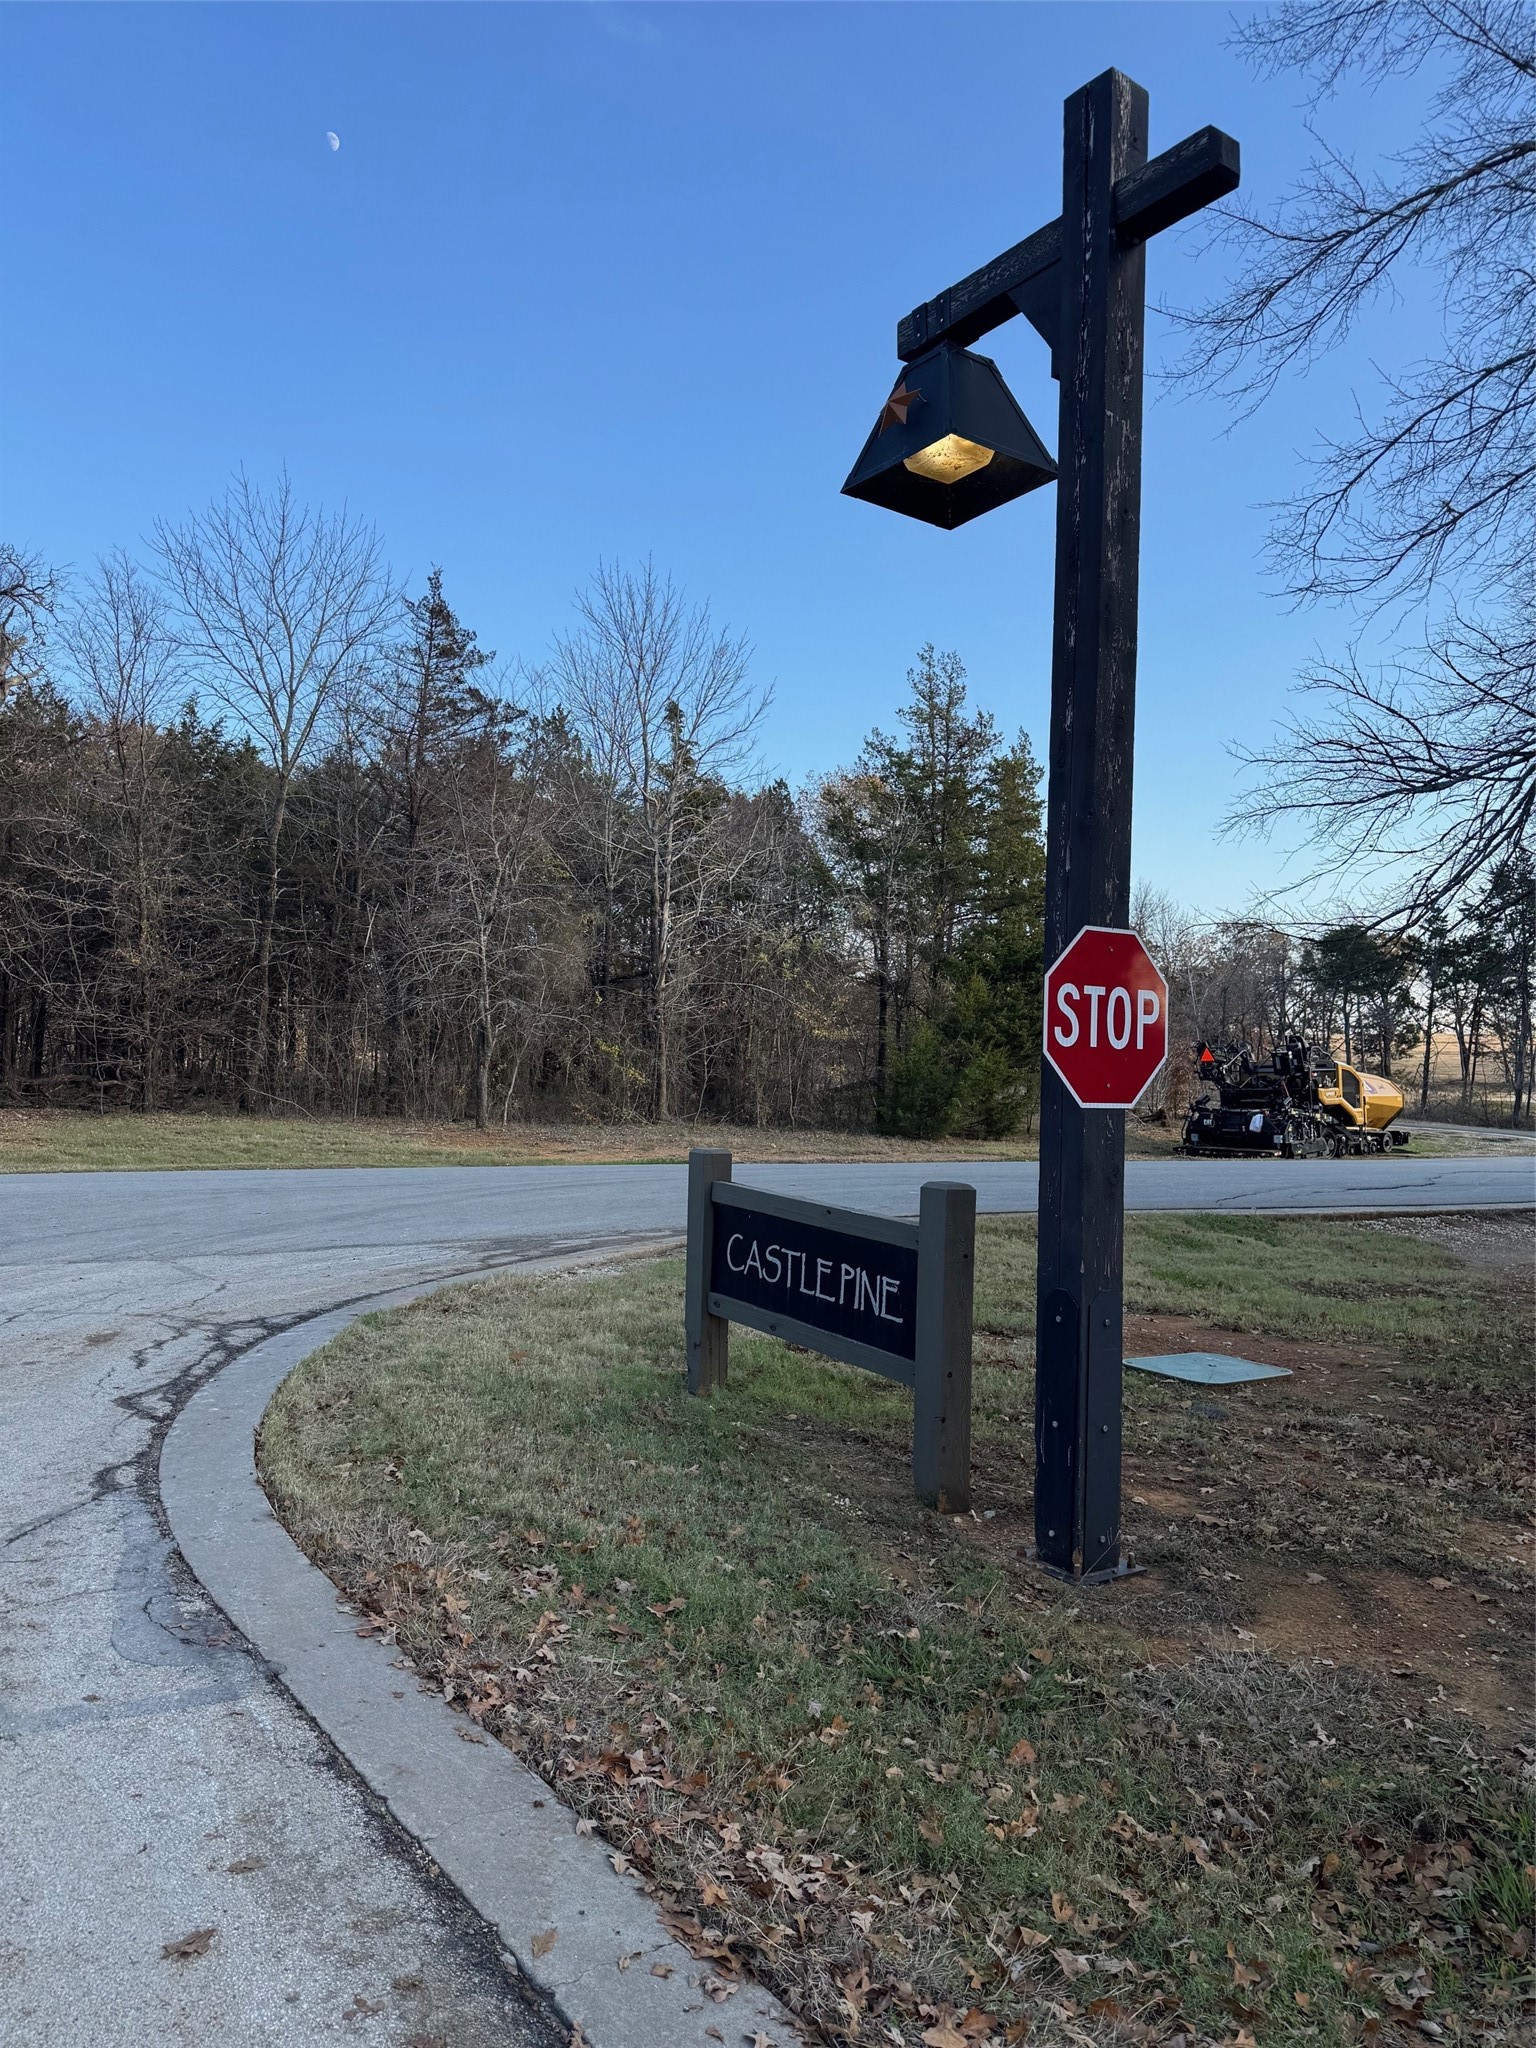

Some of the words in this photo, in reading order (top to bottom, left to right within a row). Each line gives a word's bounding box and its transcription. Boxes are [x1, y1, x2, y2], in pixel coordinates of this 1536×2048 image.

[1054, 982, 1160, 1050] STOP
[726, 1233, 835, 1302] CASTLE
[839, 1263, 903, 1323] PINE
